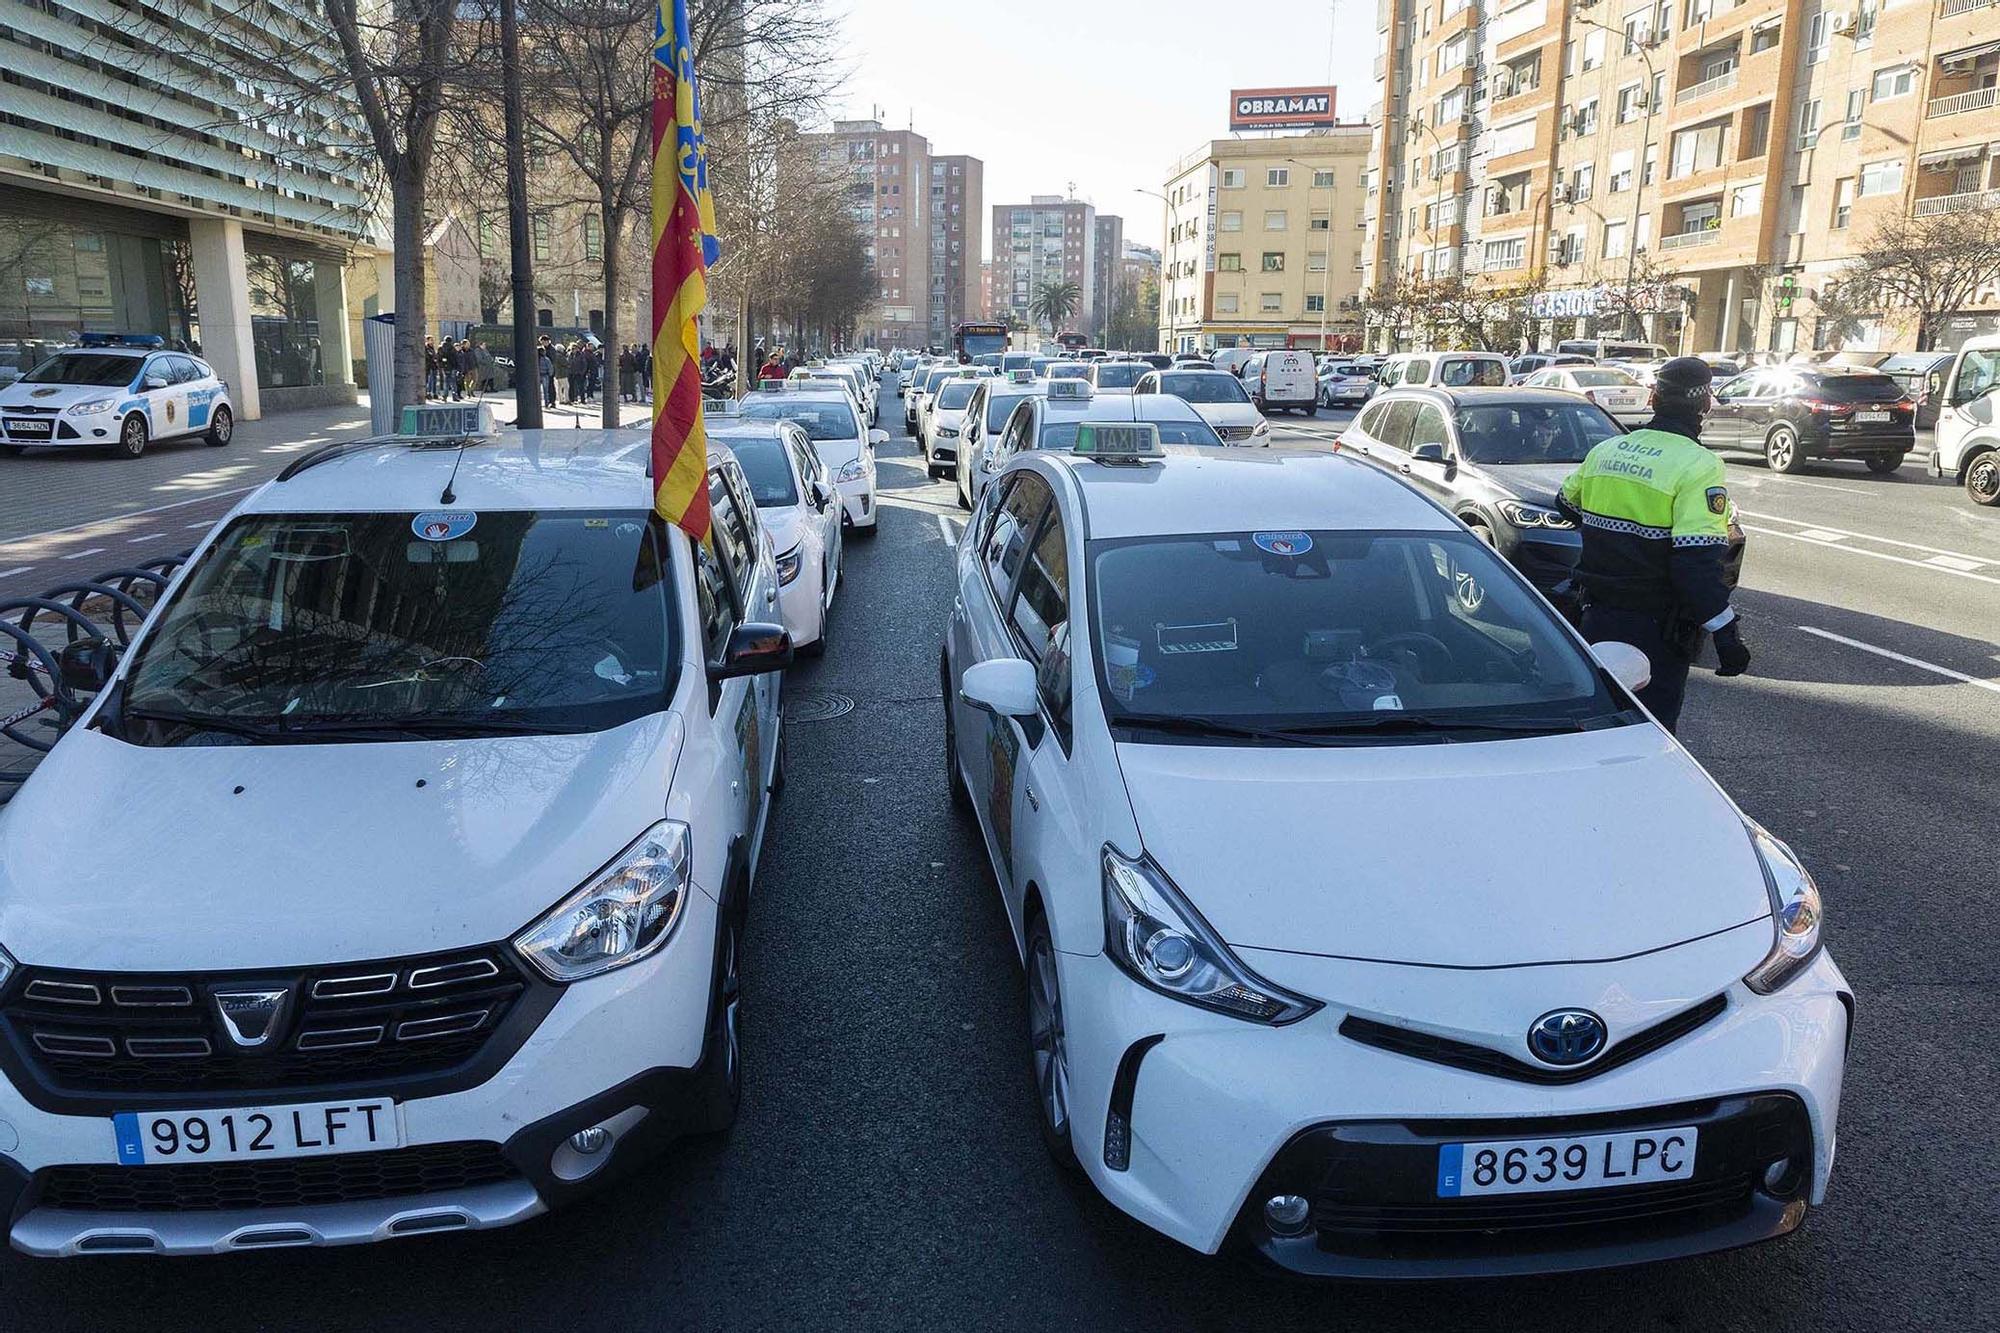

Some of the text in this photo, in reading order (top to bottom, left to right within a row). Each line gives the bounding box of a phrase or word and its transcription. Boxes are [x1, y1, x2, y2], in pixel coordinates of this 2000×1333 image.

[1239, 98, 1328, 115] OBRAMAT
[419, 410, 460, 432] TAXI
[1100, 428, 1137, 451] TAXI
[1617, 441, 1663, 457] OLICIA
[151, 1104, 383, 1155] 9912 LFT
[125, 1143, 137, 1155] E
[1472, 1136, 1685, 1187] 8639 LPC
[1444, 1175, 1456, 1187] E
